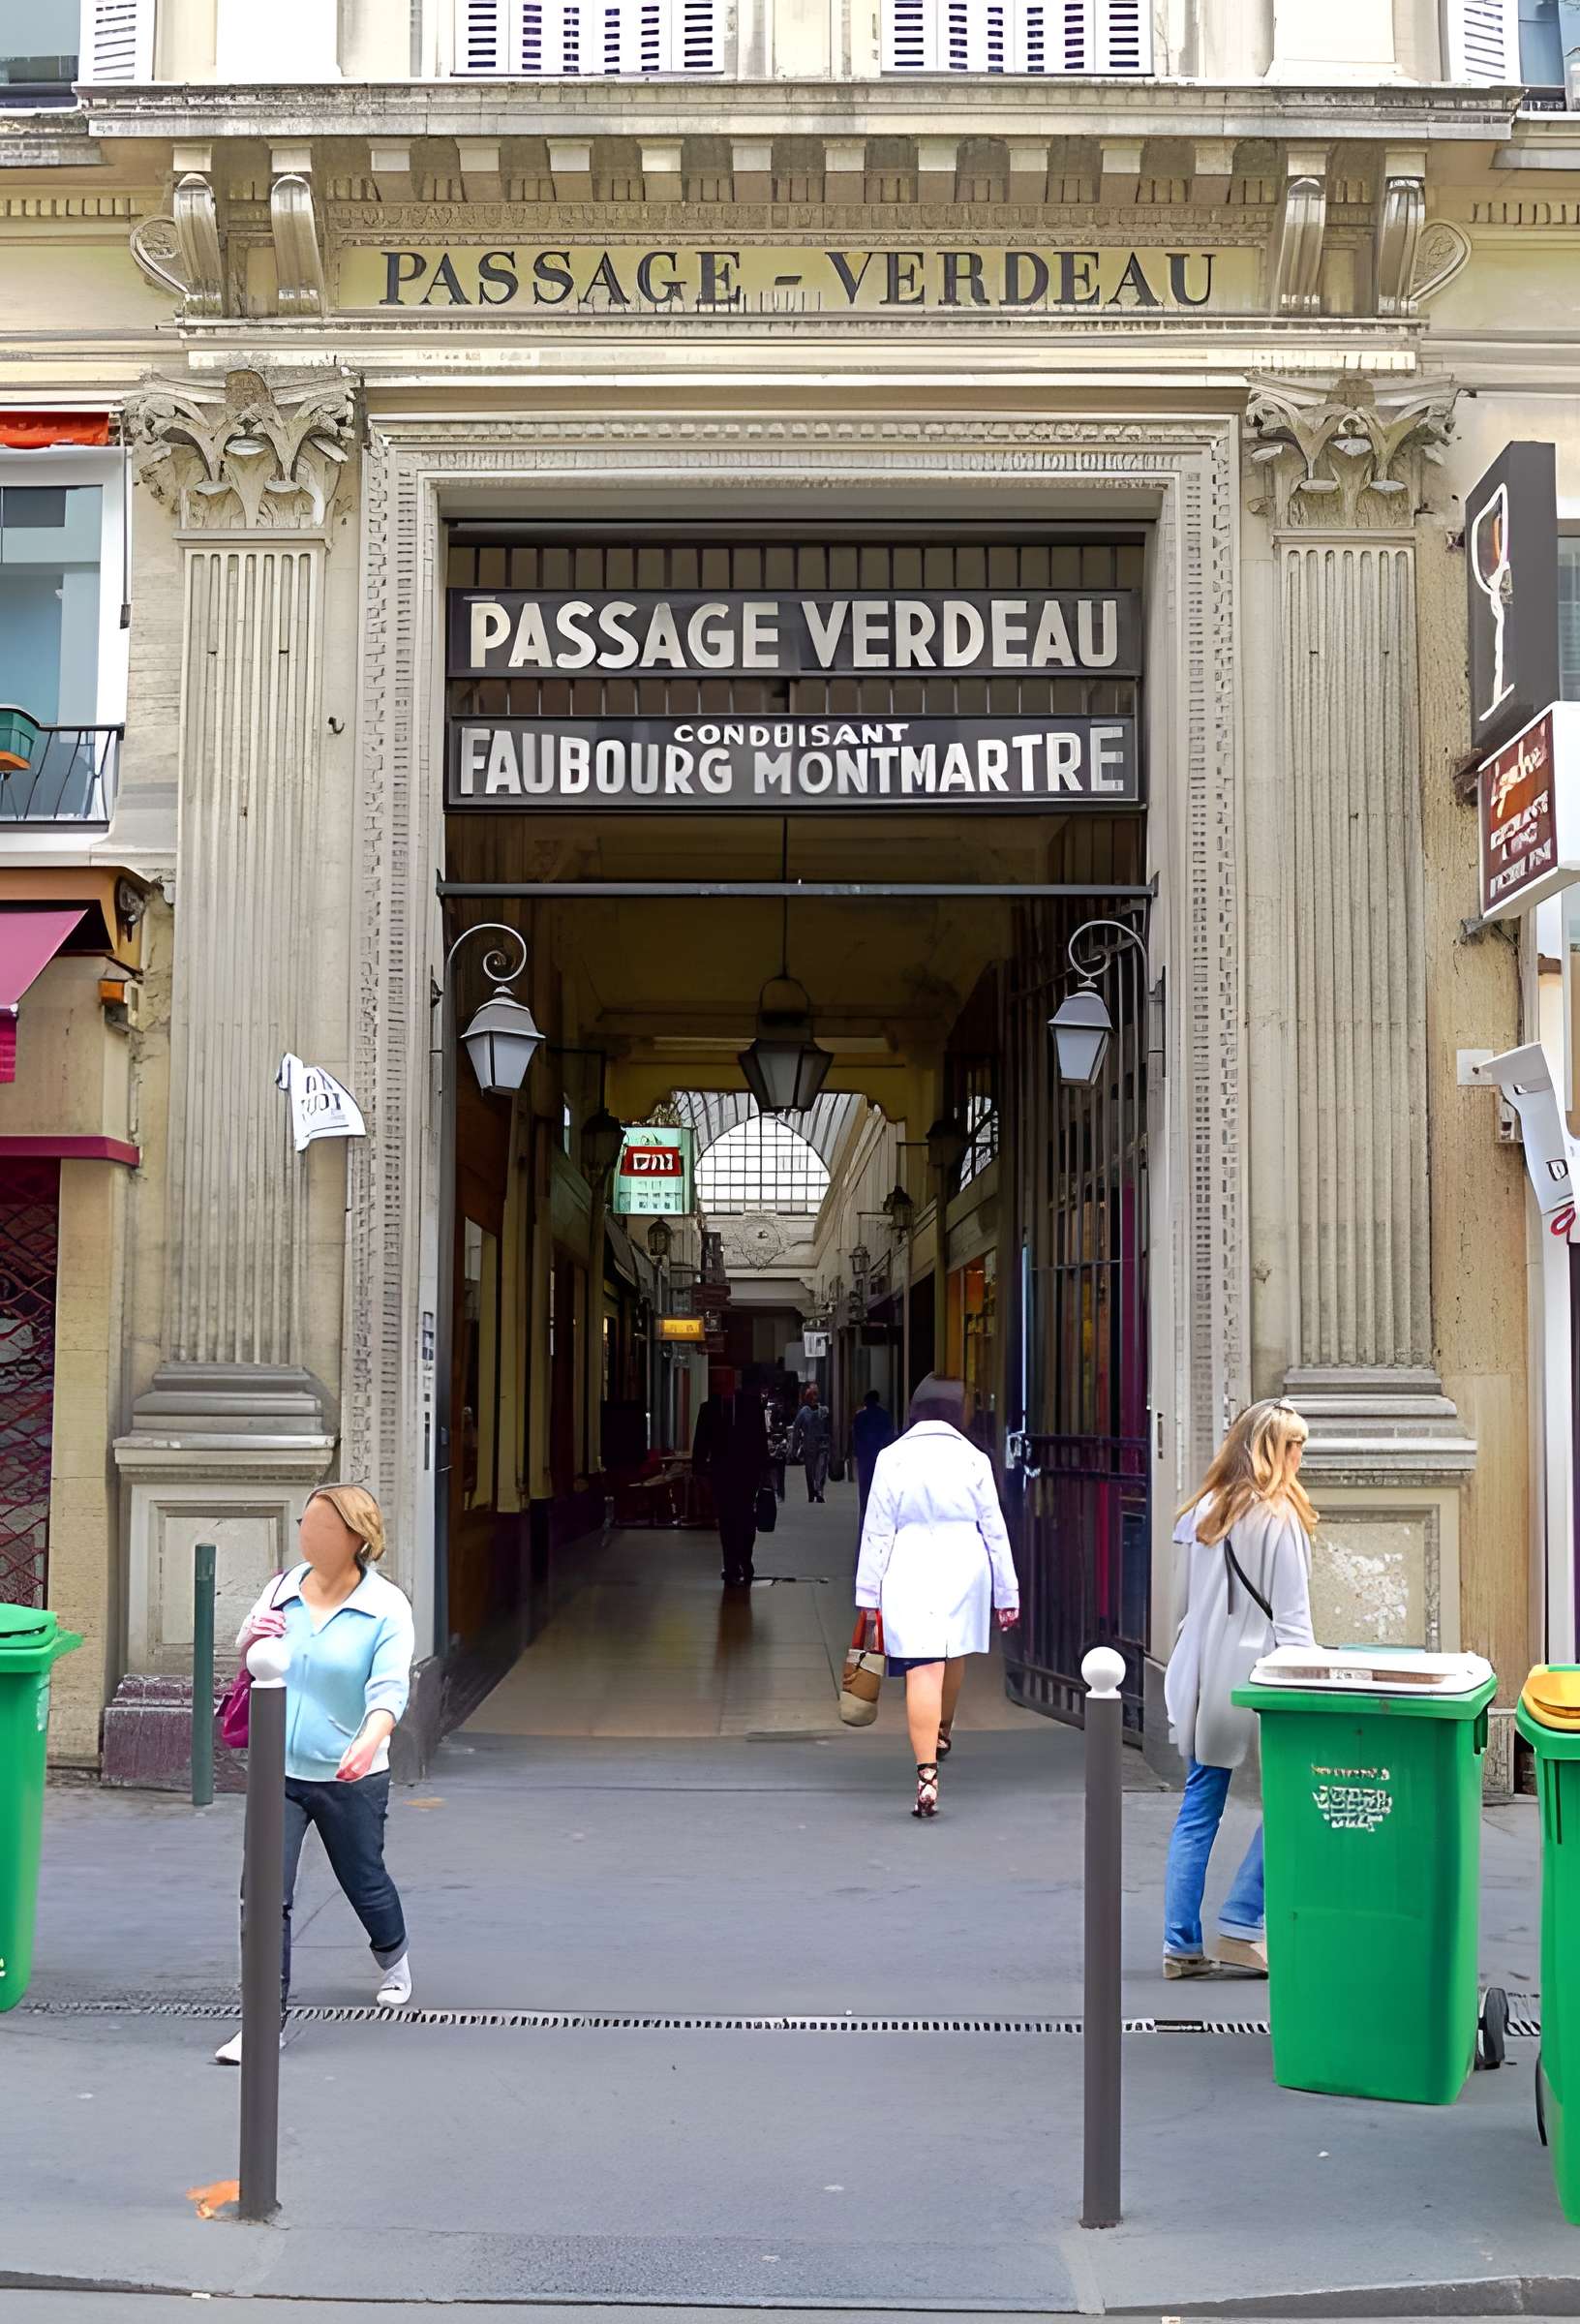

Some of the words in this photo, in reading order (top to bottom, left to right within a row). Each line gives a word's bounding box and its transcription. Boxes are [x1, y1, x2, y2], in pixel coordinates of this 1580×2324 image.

[379, 250, 741, 306] PASSAGE
[824, 250, 1217, 307] VERDEAU
[470, 600, 779, 669] PASSAGE
[801, 599, 1118, 668] VERDEAU
[460, 726, 733, 795] FAUBOURG
[753, 725, 1124, 795] MONTMARTRE
[673, 722, 910, 748] CONDUISANT
